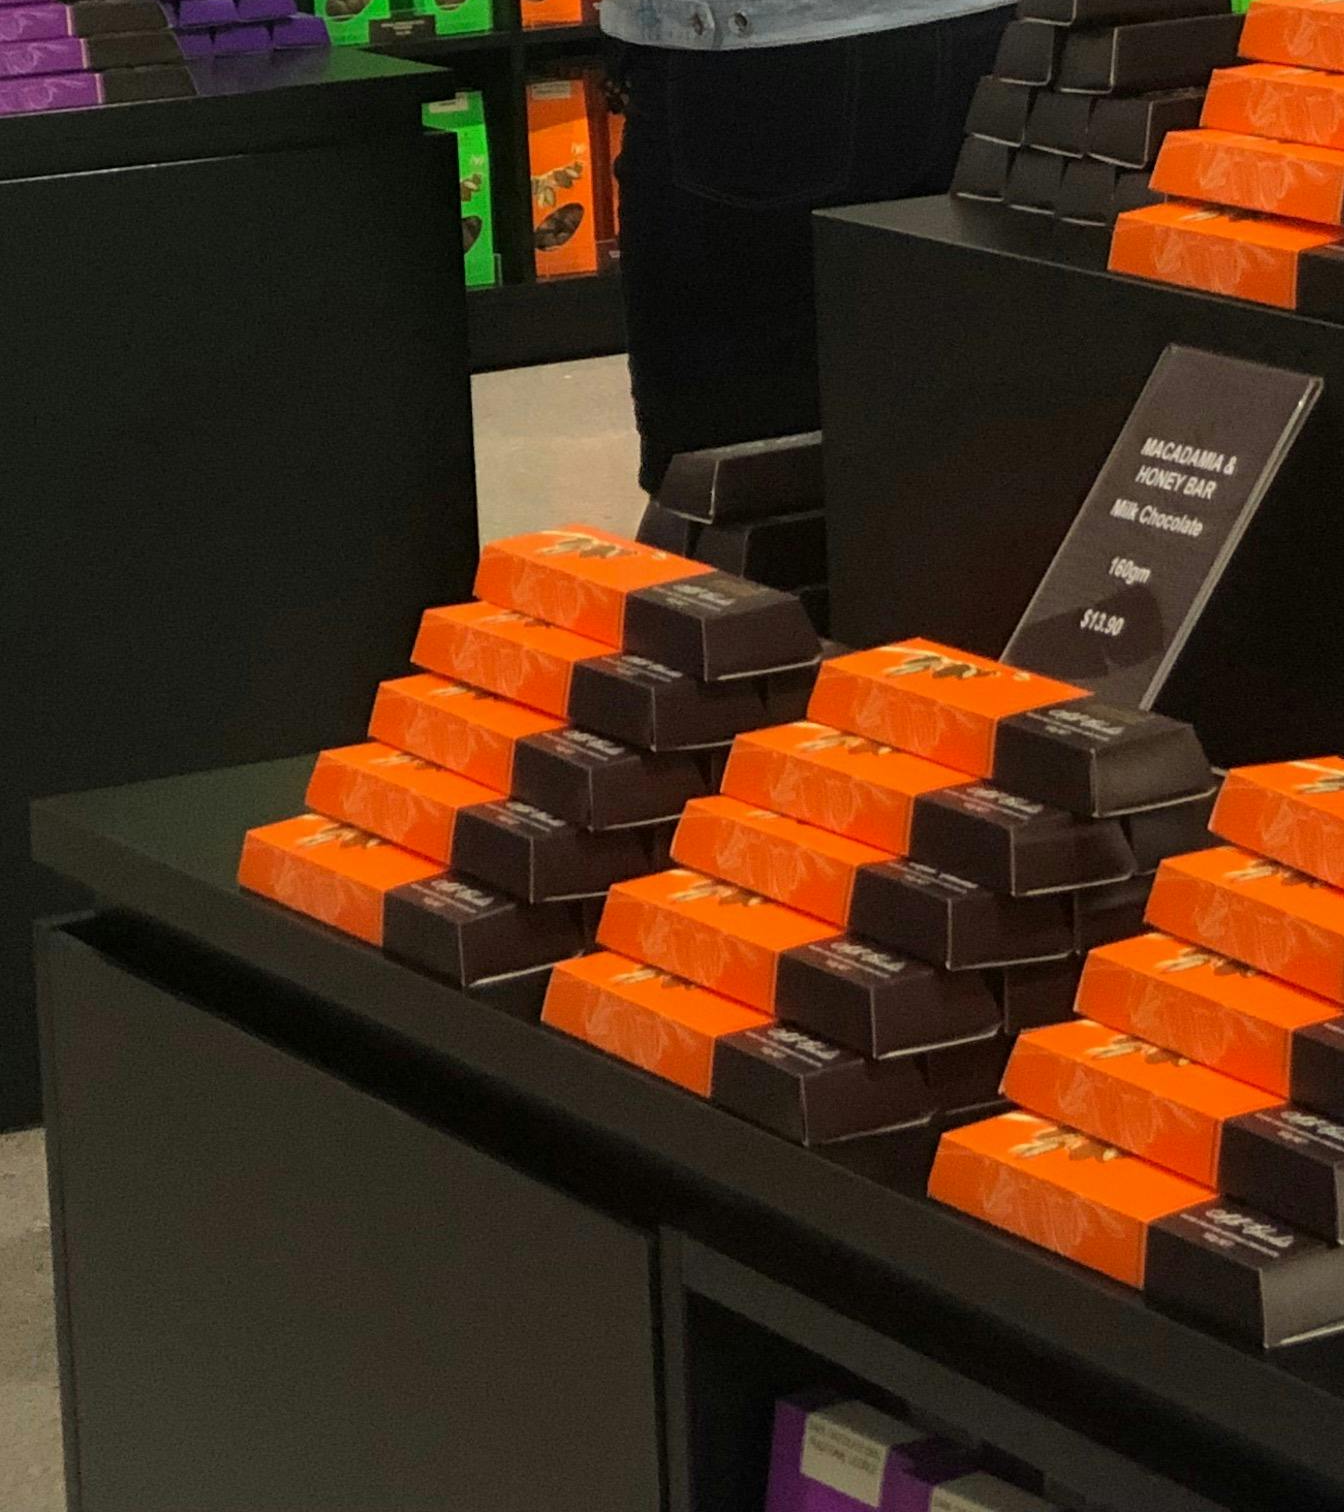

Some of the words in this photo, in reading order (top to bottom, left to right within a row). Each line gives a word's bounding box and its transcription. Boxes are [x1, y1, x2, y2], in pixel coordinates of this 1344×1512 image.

[1141, 438, 1226, 473] MACADAMIA
[1223, 456, 1237, 476] &
[1135, 466, 1185, 493] HONEY
[1183, 478, 1218, 500] BAR
[1110, 498, 1140, 522] Milk
[1139, 504, 1204, 537] Chocolate
[1108, 556, 1151, 585] 160gm
[1080, 608, 1125, 636] $13.90
